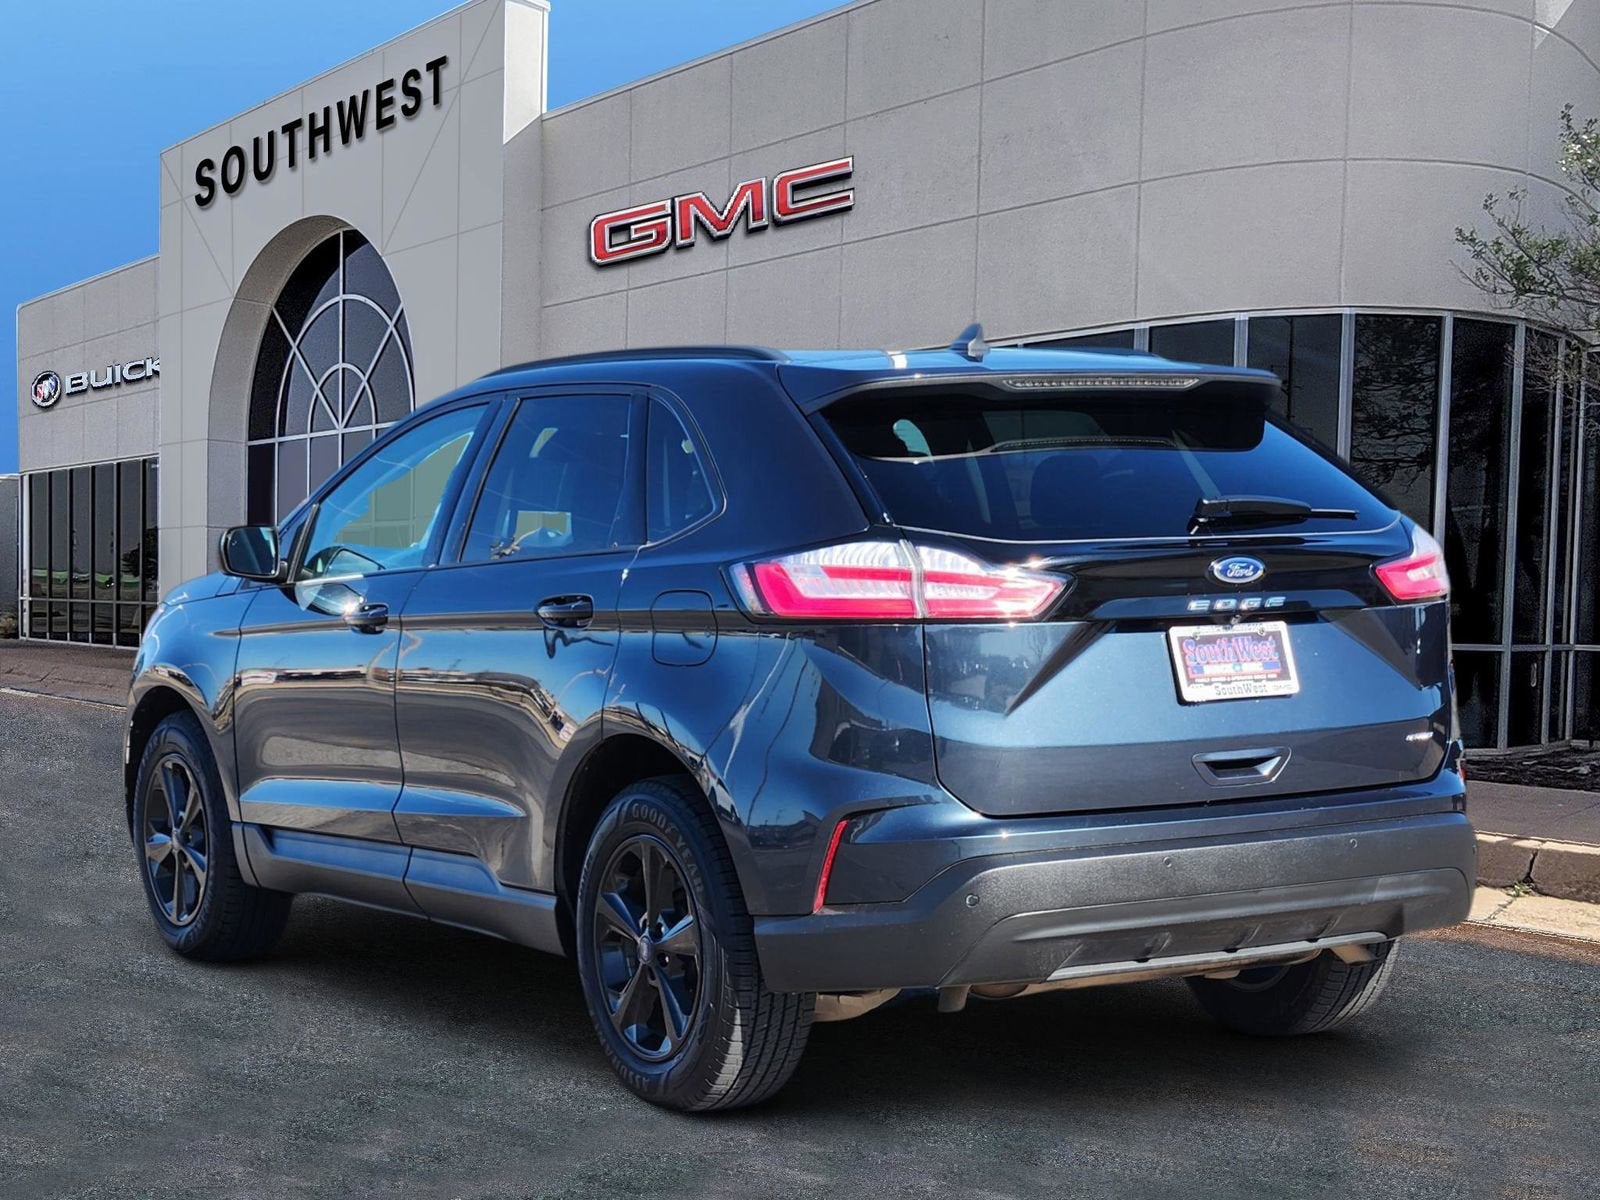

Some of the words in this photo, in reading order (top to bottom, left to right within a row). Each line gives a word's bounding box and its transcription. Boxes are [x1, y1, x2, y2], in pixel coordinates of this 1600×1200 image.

[195, 55, 448, 207] SOUTHWEST
[589, 155, 855, 268] GMC
[1226, 562, 1254, 578] Ford
[1186, 596, 1287, 611] EDGE
[1214, 681, 1268, 696] SouthWest
